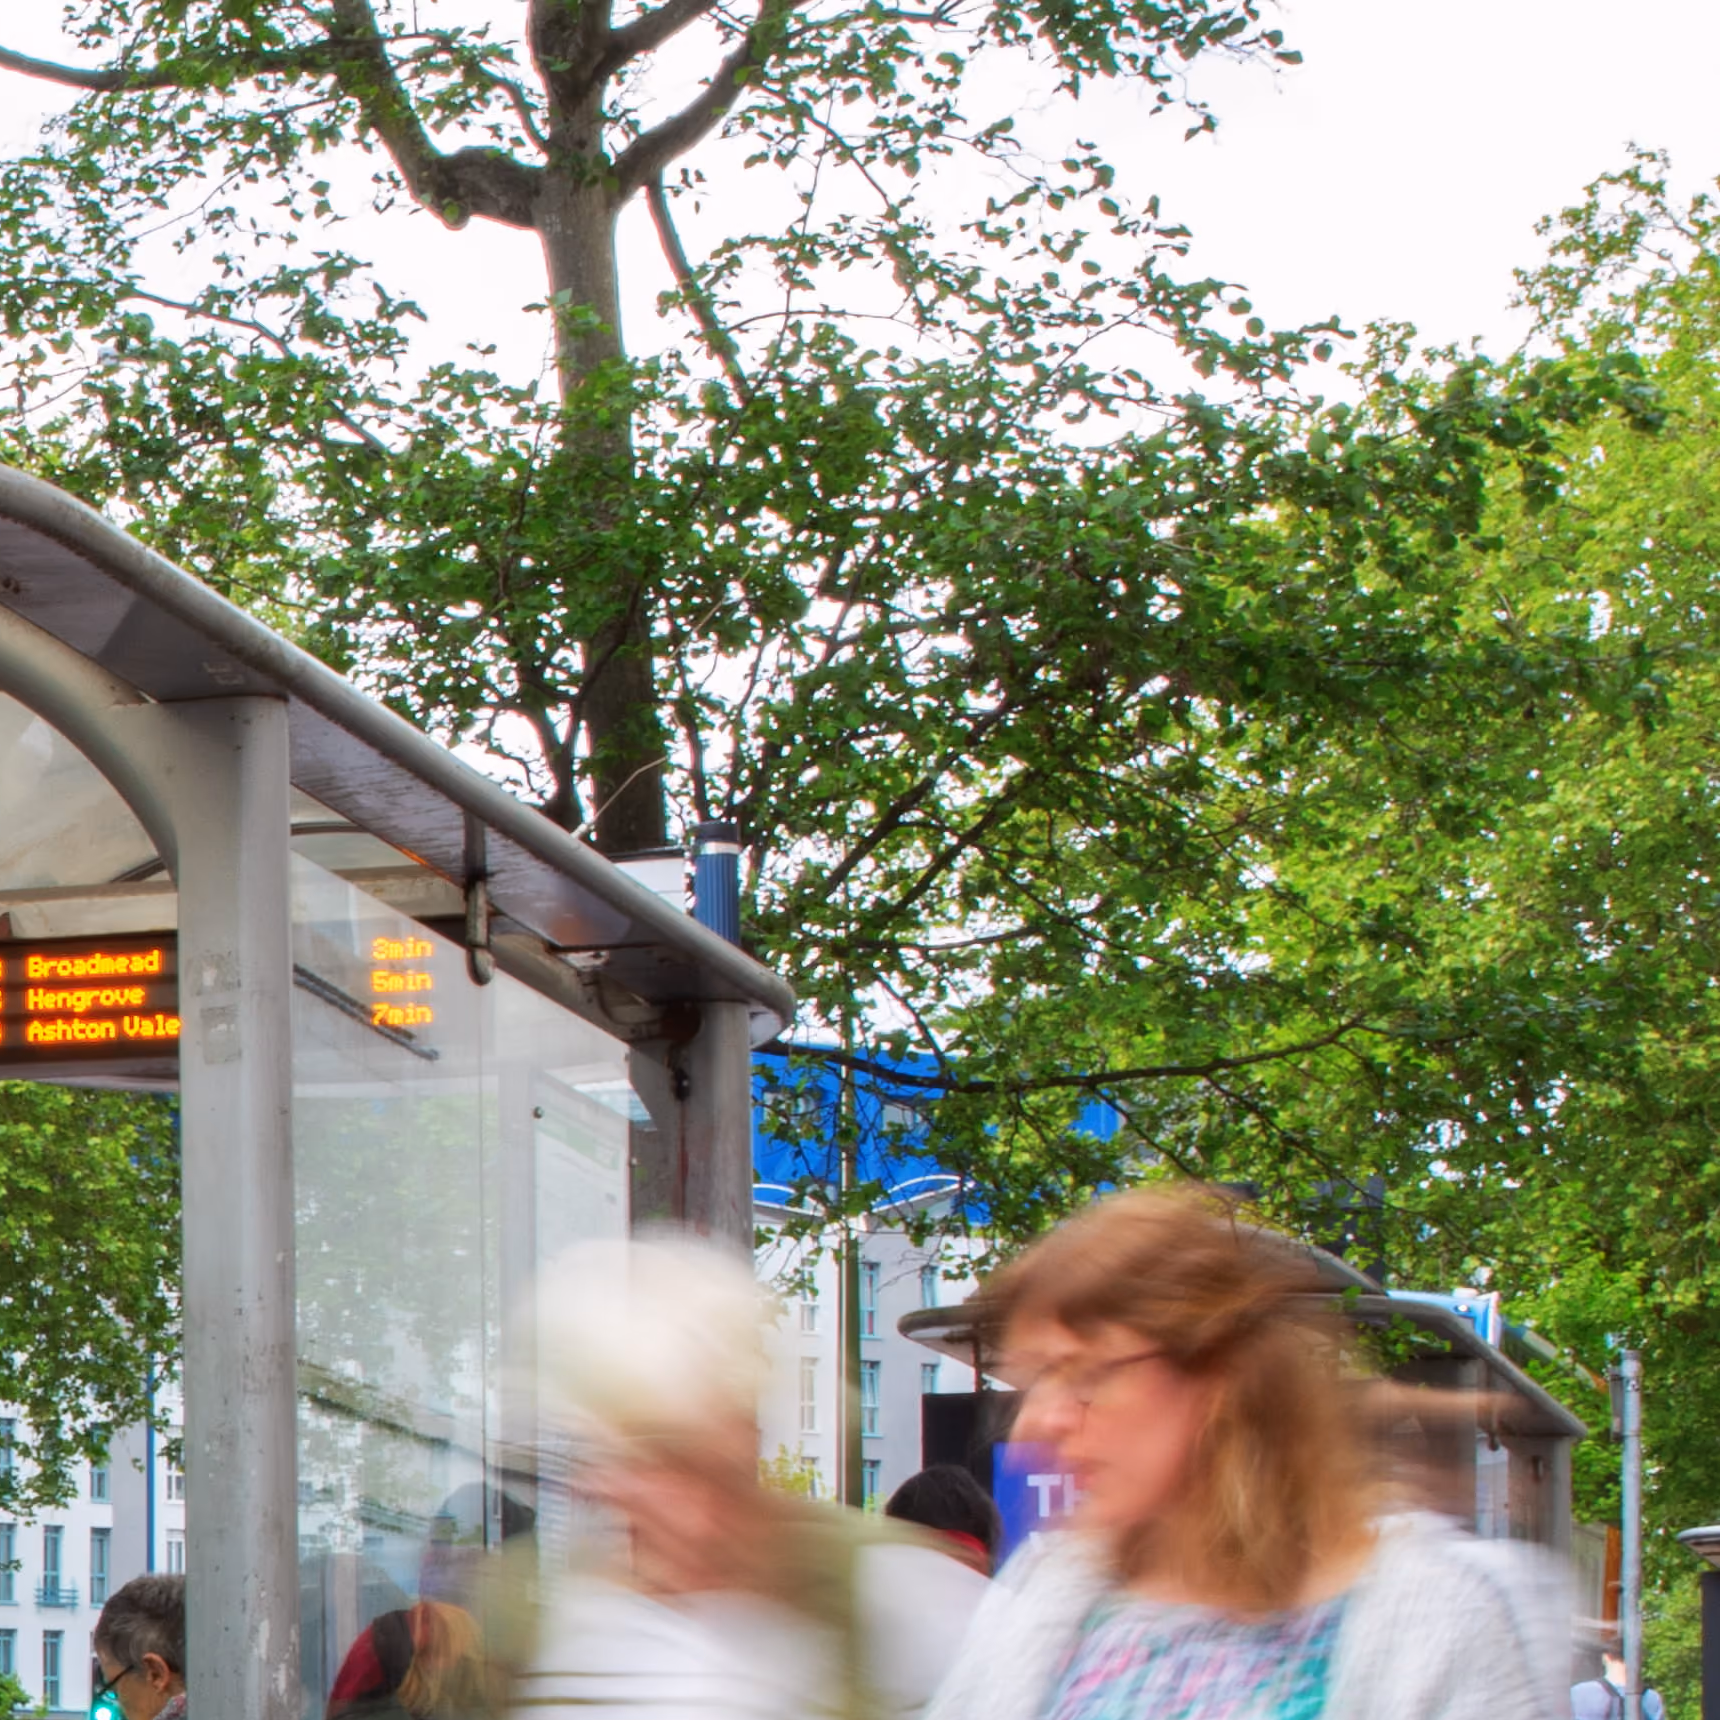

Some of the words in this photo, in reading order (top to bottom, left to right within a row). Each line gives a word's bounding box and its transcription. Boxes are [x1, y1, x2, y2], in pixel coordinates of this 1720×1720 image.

[27, 950, 162, 978] Broadmead
[372, 937, 434, 960] 3min
[27, 987, 145, 1012] Hengrove
[372, 970, 434, 993] 5min
[27, 1018, 116, 1042] Ashton
[123, 1014, 182, 1037] Vale
[372, 1002, 434, 1025] 7min
